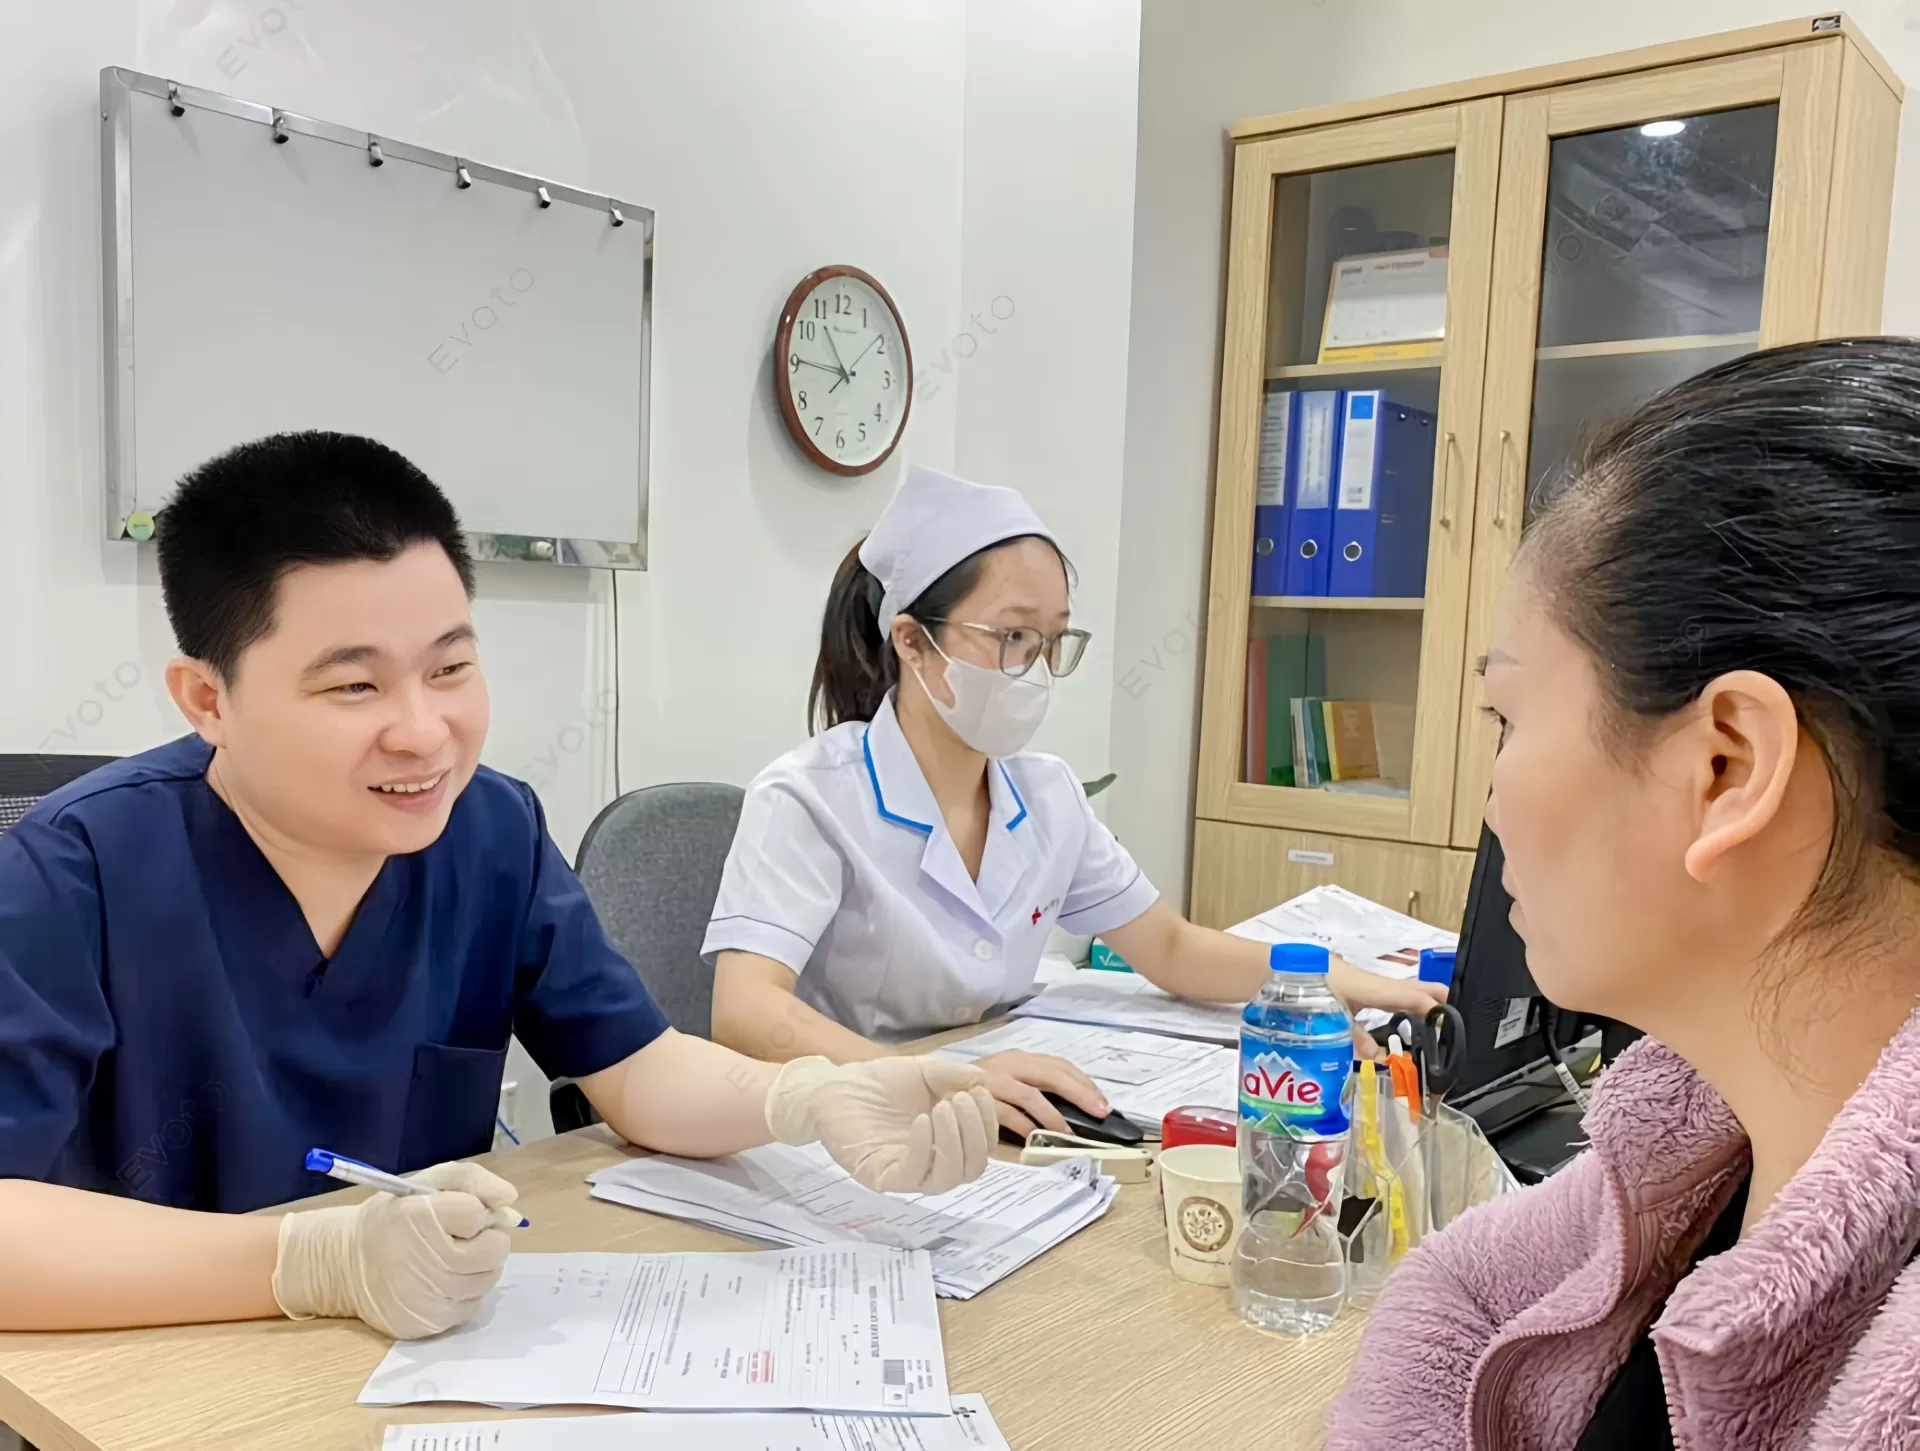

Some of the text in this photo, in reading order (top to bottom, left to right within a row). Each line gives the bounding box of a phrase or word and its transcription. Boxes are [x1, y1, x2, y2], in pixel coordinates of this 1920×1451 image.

[814, 299, 827, 320] 11
[834, 294, 852, 315] 12
[862, 308, 867, 328] 1
[798, 320, 815, 342] 10
[876, 333, 885, 354] 2
[790, 354, 800, 374] 9
[883, 371, 891, 389] 3
[798, 391, 807, 410] 8
[874, 403, 882, 422] 4
[814, 417, 824, 436] 7
[858, 423, 866, 442] 5
[836, 430, 845, 448] 6
